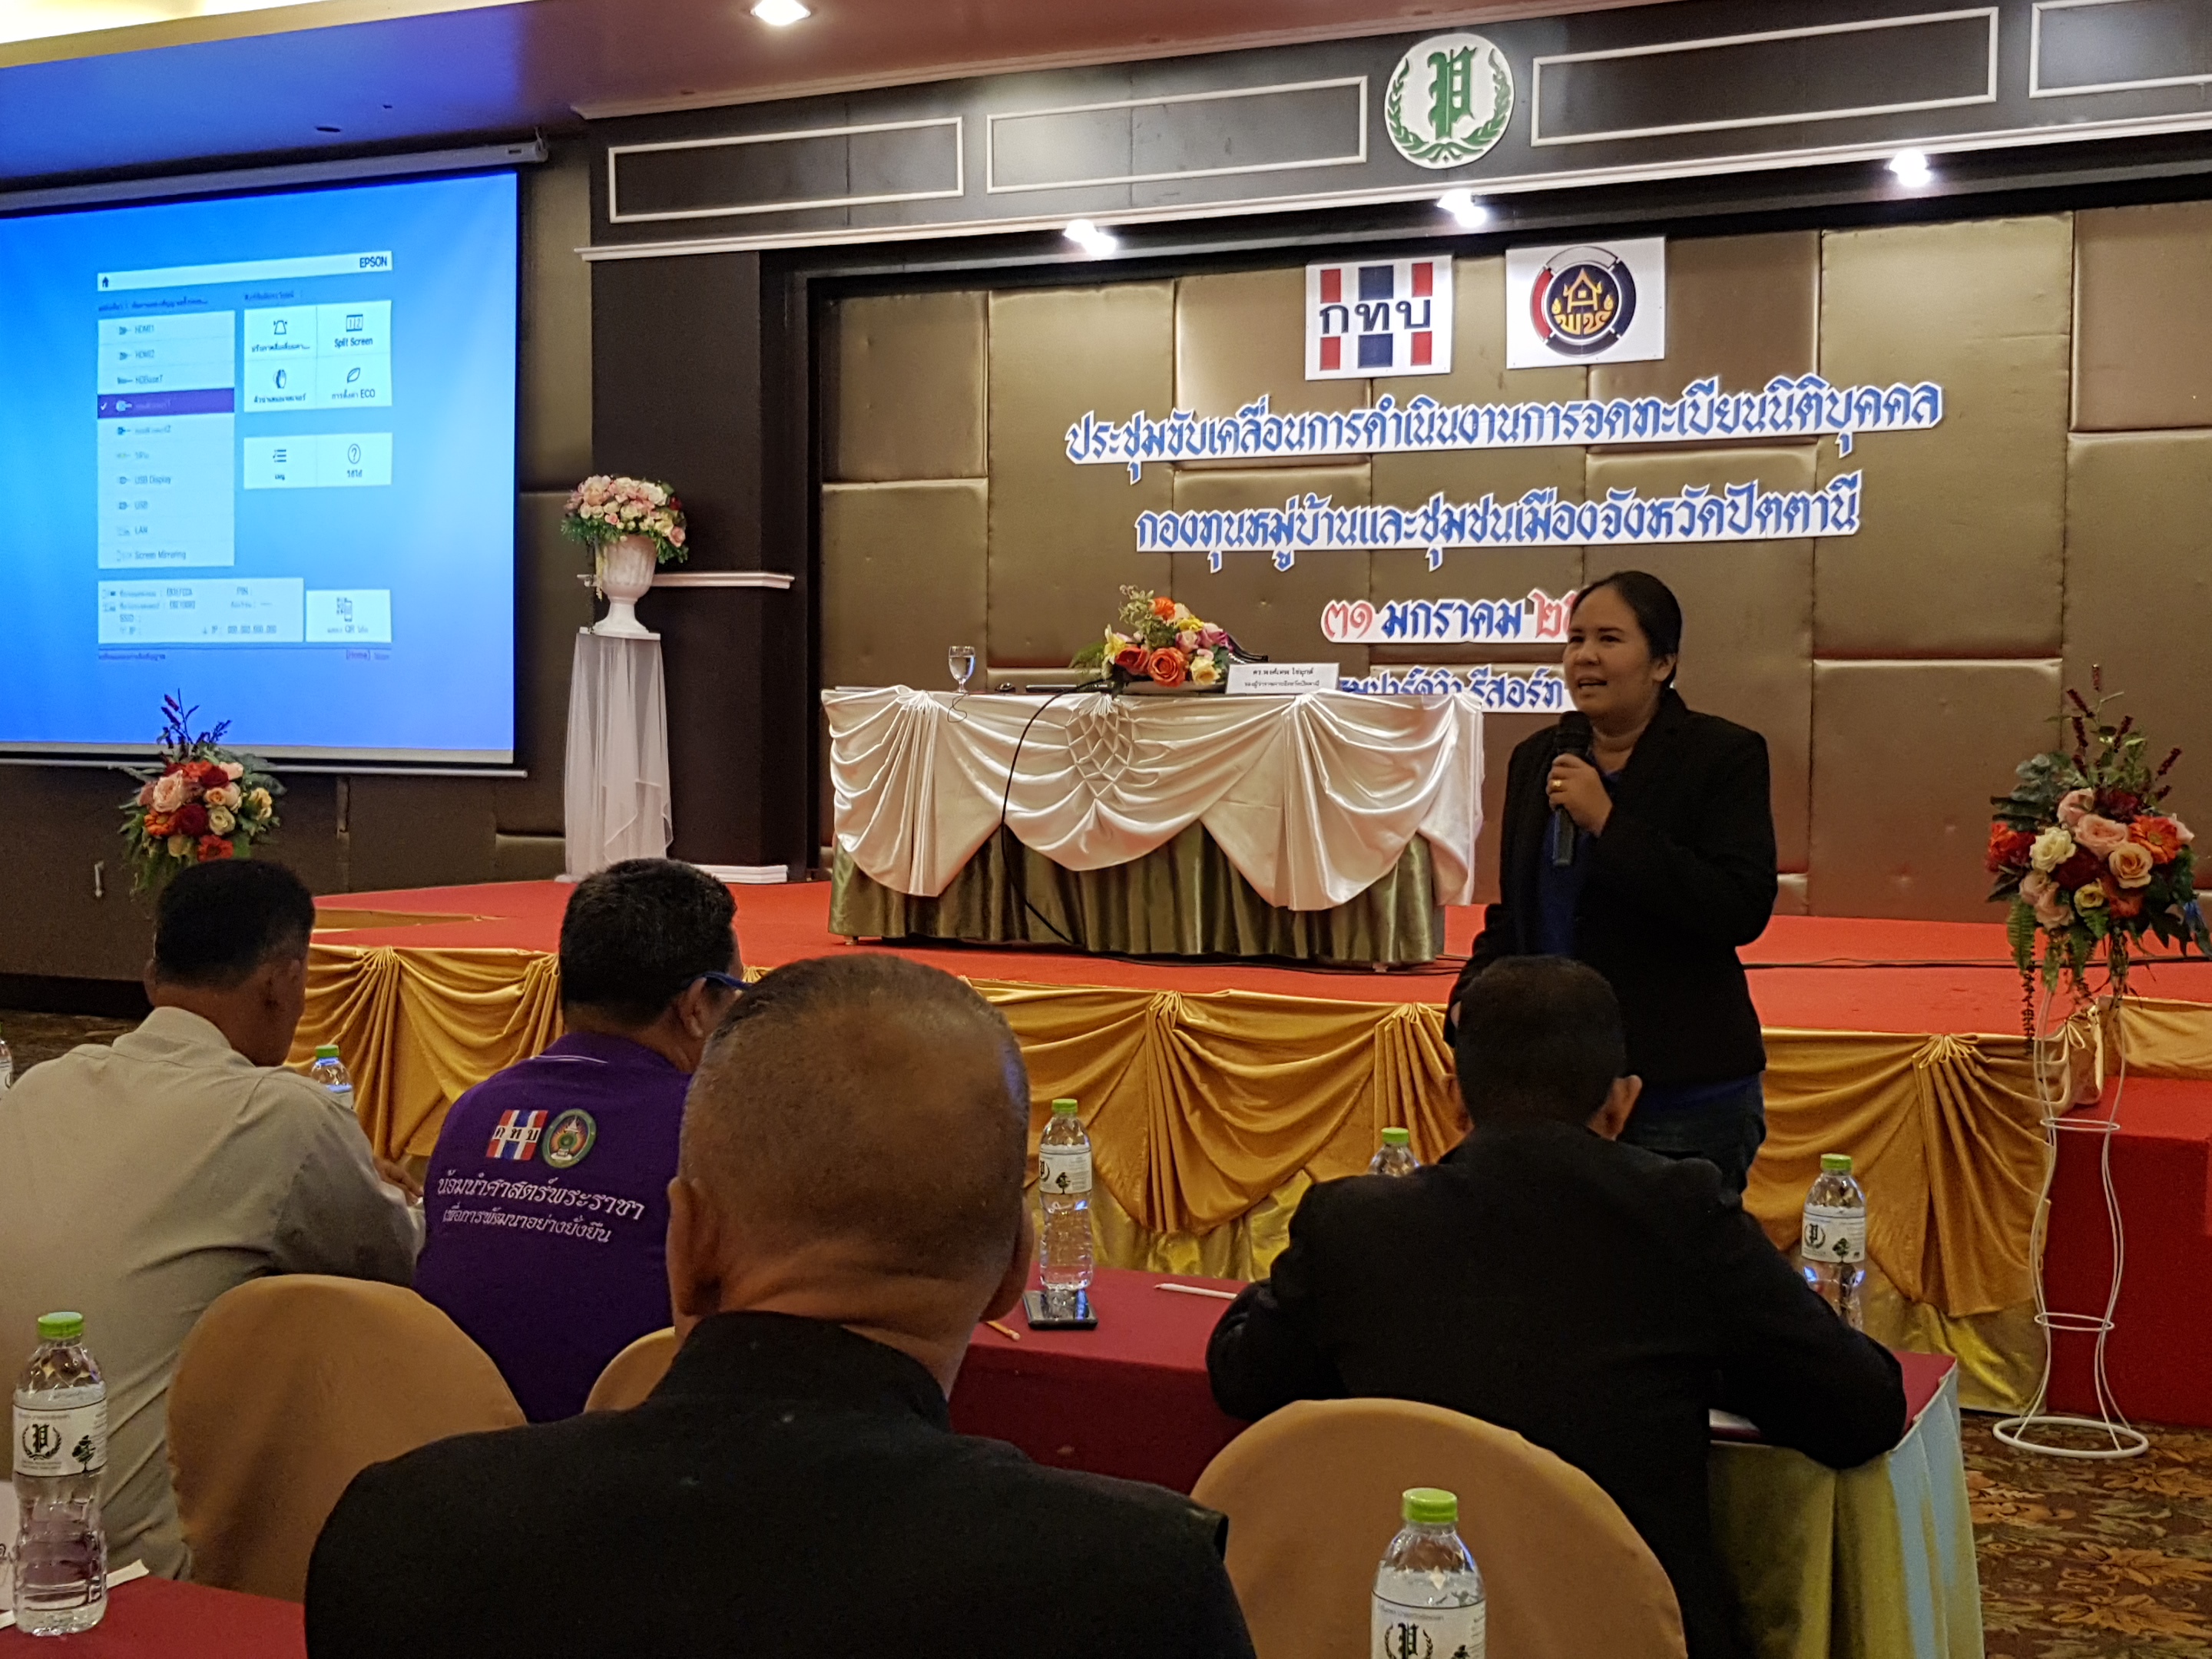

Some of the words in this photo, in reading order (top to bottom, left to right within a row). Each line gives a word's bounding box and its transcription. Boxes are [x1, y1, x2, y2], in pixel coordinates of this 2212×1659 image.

[359, 256, 387, 268] EPSON
[1319, 298, 1431, 335] กทบ
[334, 338, 348, 349] Split
[350, 337, 373, 346] Screen
[360, 389, 376, 399] ECO
[1067, 376, 1939, 482] ประชุมขับเคลื่อนการดำเนินงานการจดทะเบียนนิติบุคคล
[1137, 472, 1860, 571] กองทุนหมู่บ้านและชุมชนเมืองจังหวัดปัตตานี
[134, 526, 147, 535] LAN
[1324, 601, 1373, 639] ๓๑
[1381, 601, 1525, 639] มกราคม
[495, 1126, 539, 1142] กทบ
